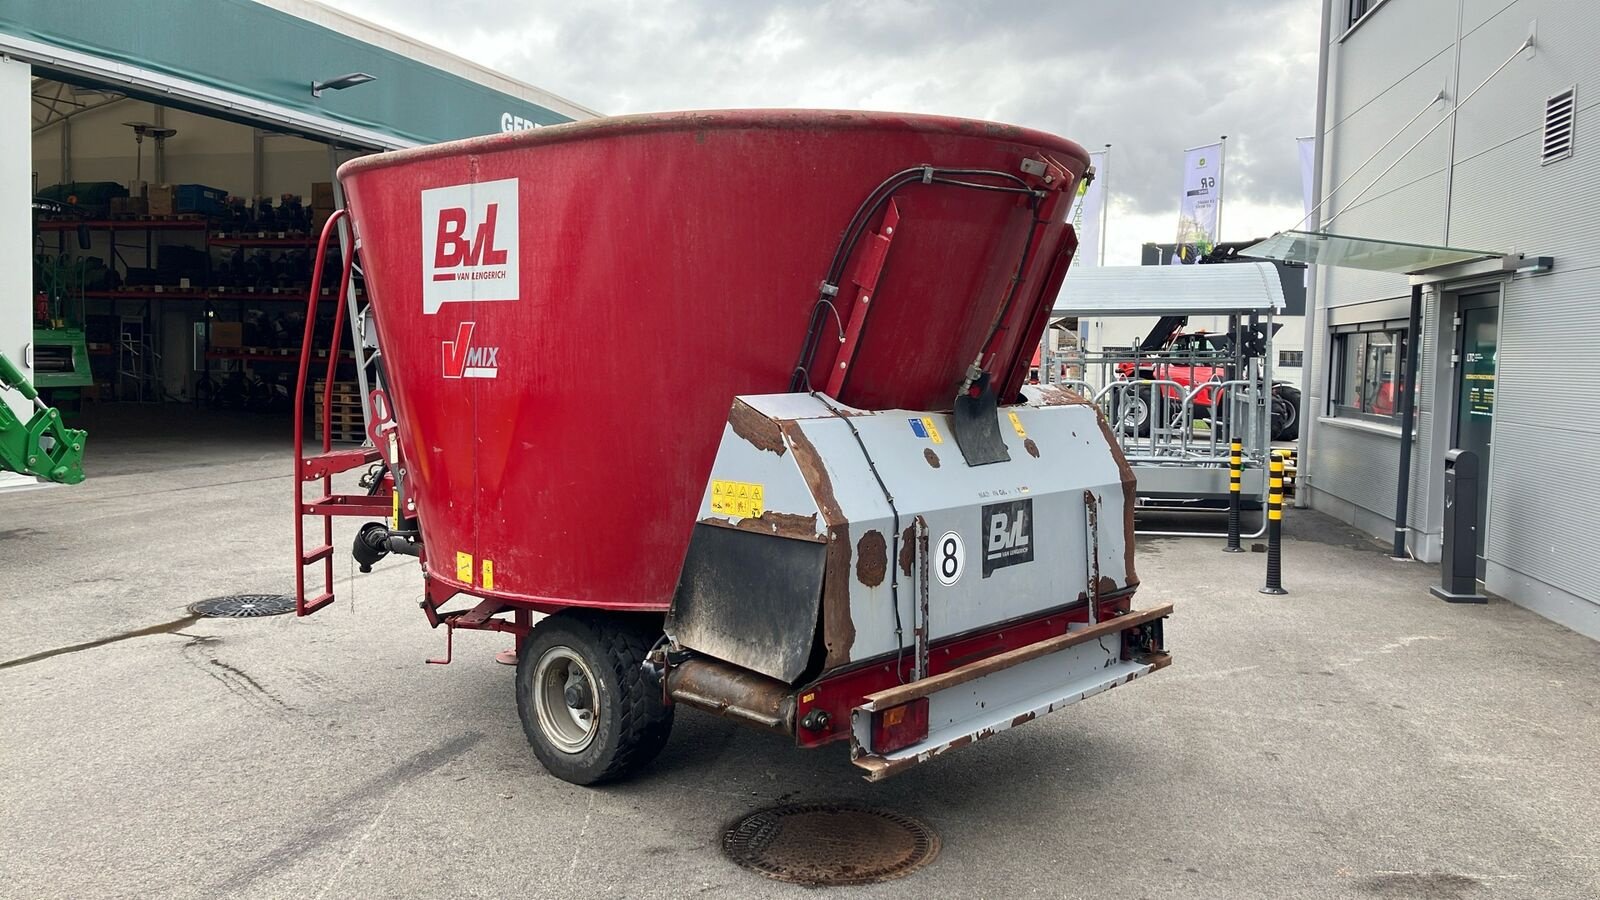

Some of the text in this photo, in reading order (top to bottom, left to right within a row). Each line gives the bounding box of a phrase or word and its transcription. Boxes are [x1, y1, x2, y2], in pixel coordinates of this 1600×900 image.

[457, 270, 506, 281] VAN LENGERICH
[942, 537, 958, 578] 8
